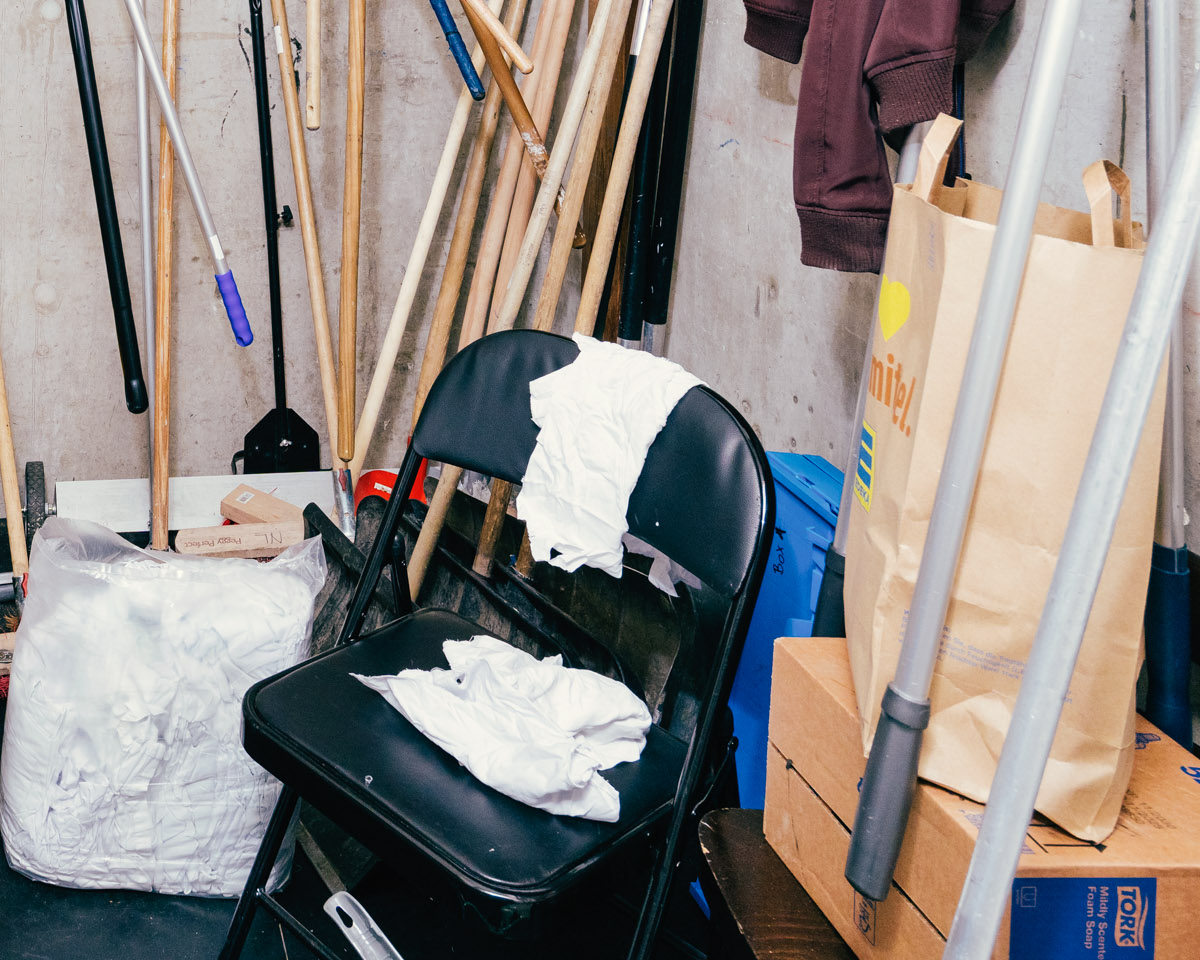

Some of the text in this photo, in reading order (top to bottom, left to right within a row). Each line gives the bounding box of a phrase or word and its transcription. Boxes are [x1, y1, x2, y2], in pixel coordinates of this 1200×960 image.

[216, 537, 242, 546] Peggy
[772, 545, 785, 575] Box
[1084, 886, 1097, 949] Foam Soap
[1097, 886, 1109, 960] Mildly Scente
[1119, 888, 1137, 944] TORK
